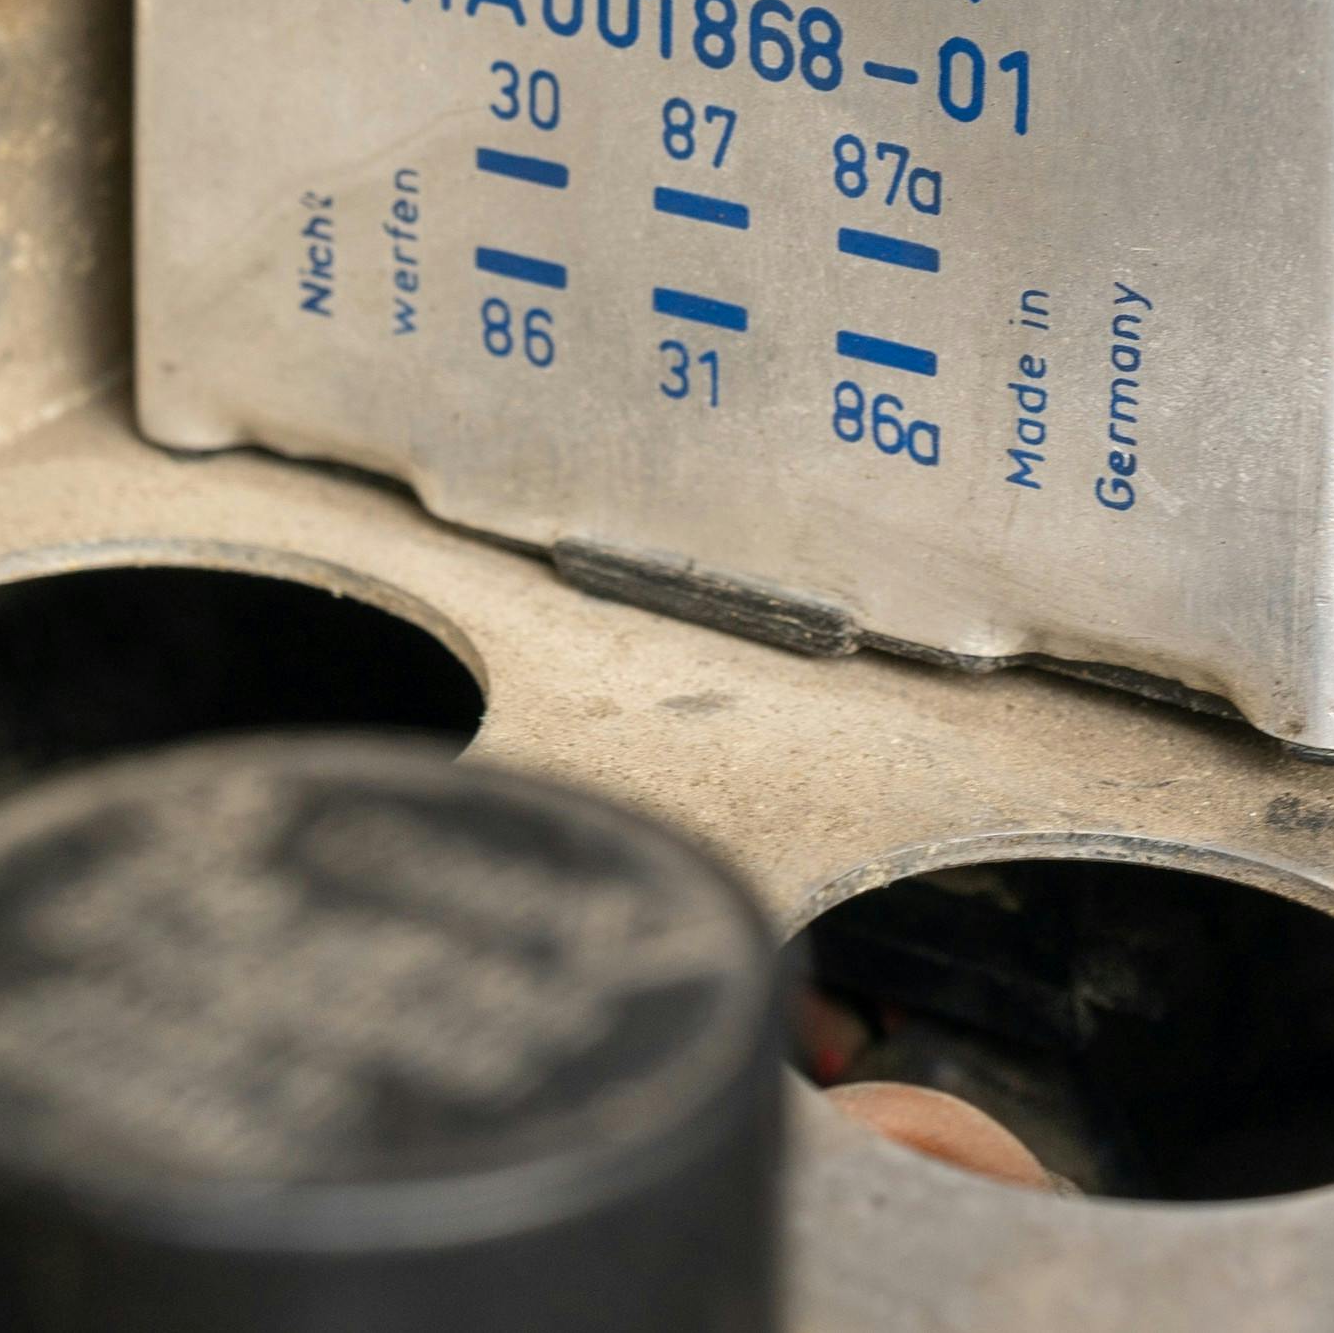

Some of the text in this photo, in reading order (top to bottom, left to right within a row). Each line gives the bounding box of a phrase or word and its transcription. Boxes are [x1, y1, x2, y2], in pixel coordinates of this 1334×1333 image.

[490, 61, 943, 216] 30 87 87a
[381, 167, 420, 337] werfen
[480, 296, 942, 466] 86 31 86a
[1005, 288, 1051, 491] Made in
[1094, 280, 1154, 512] Germany
